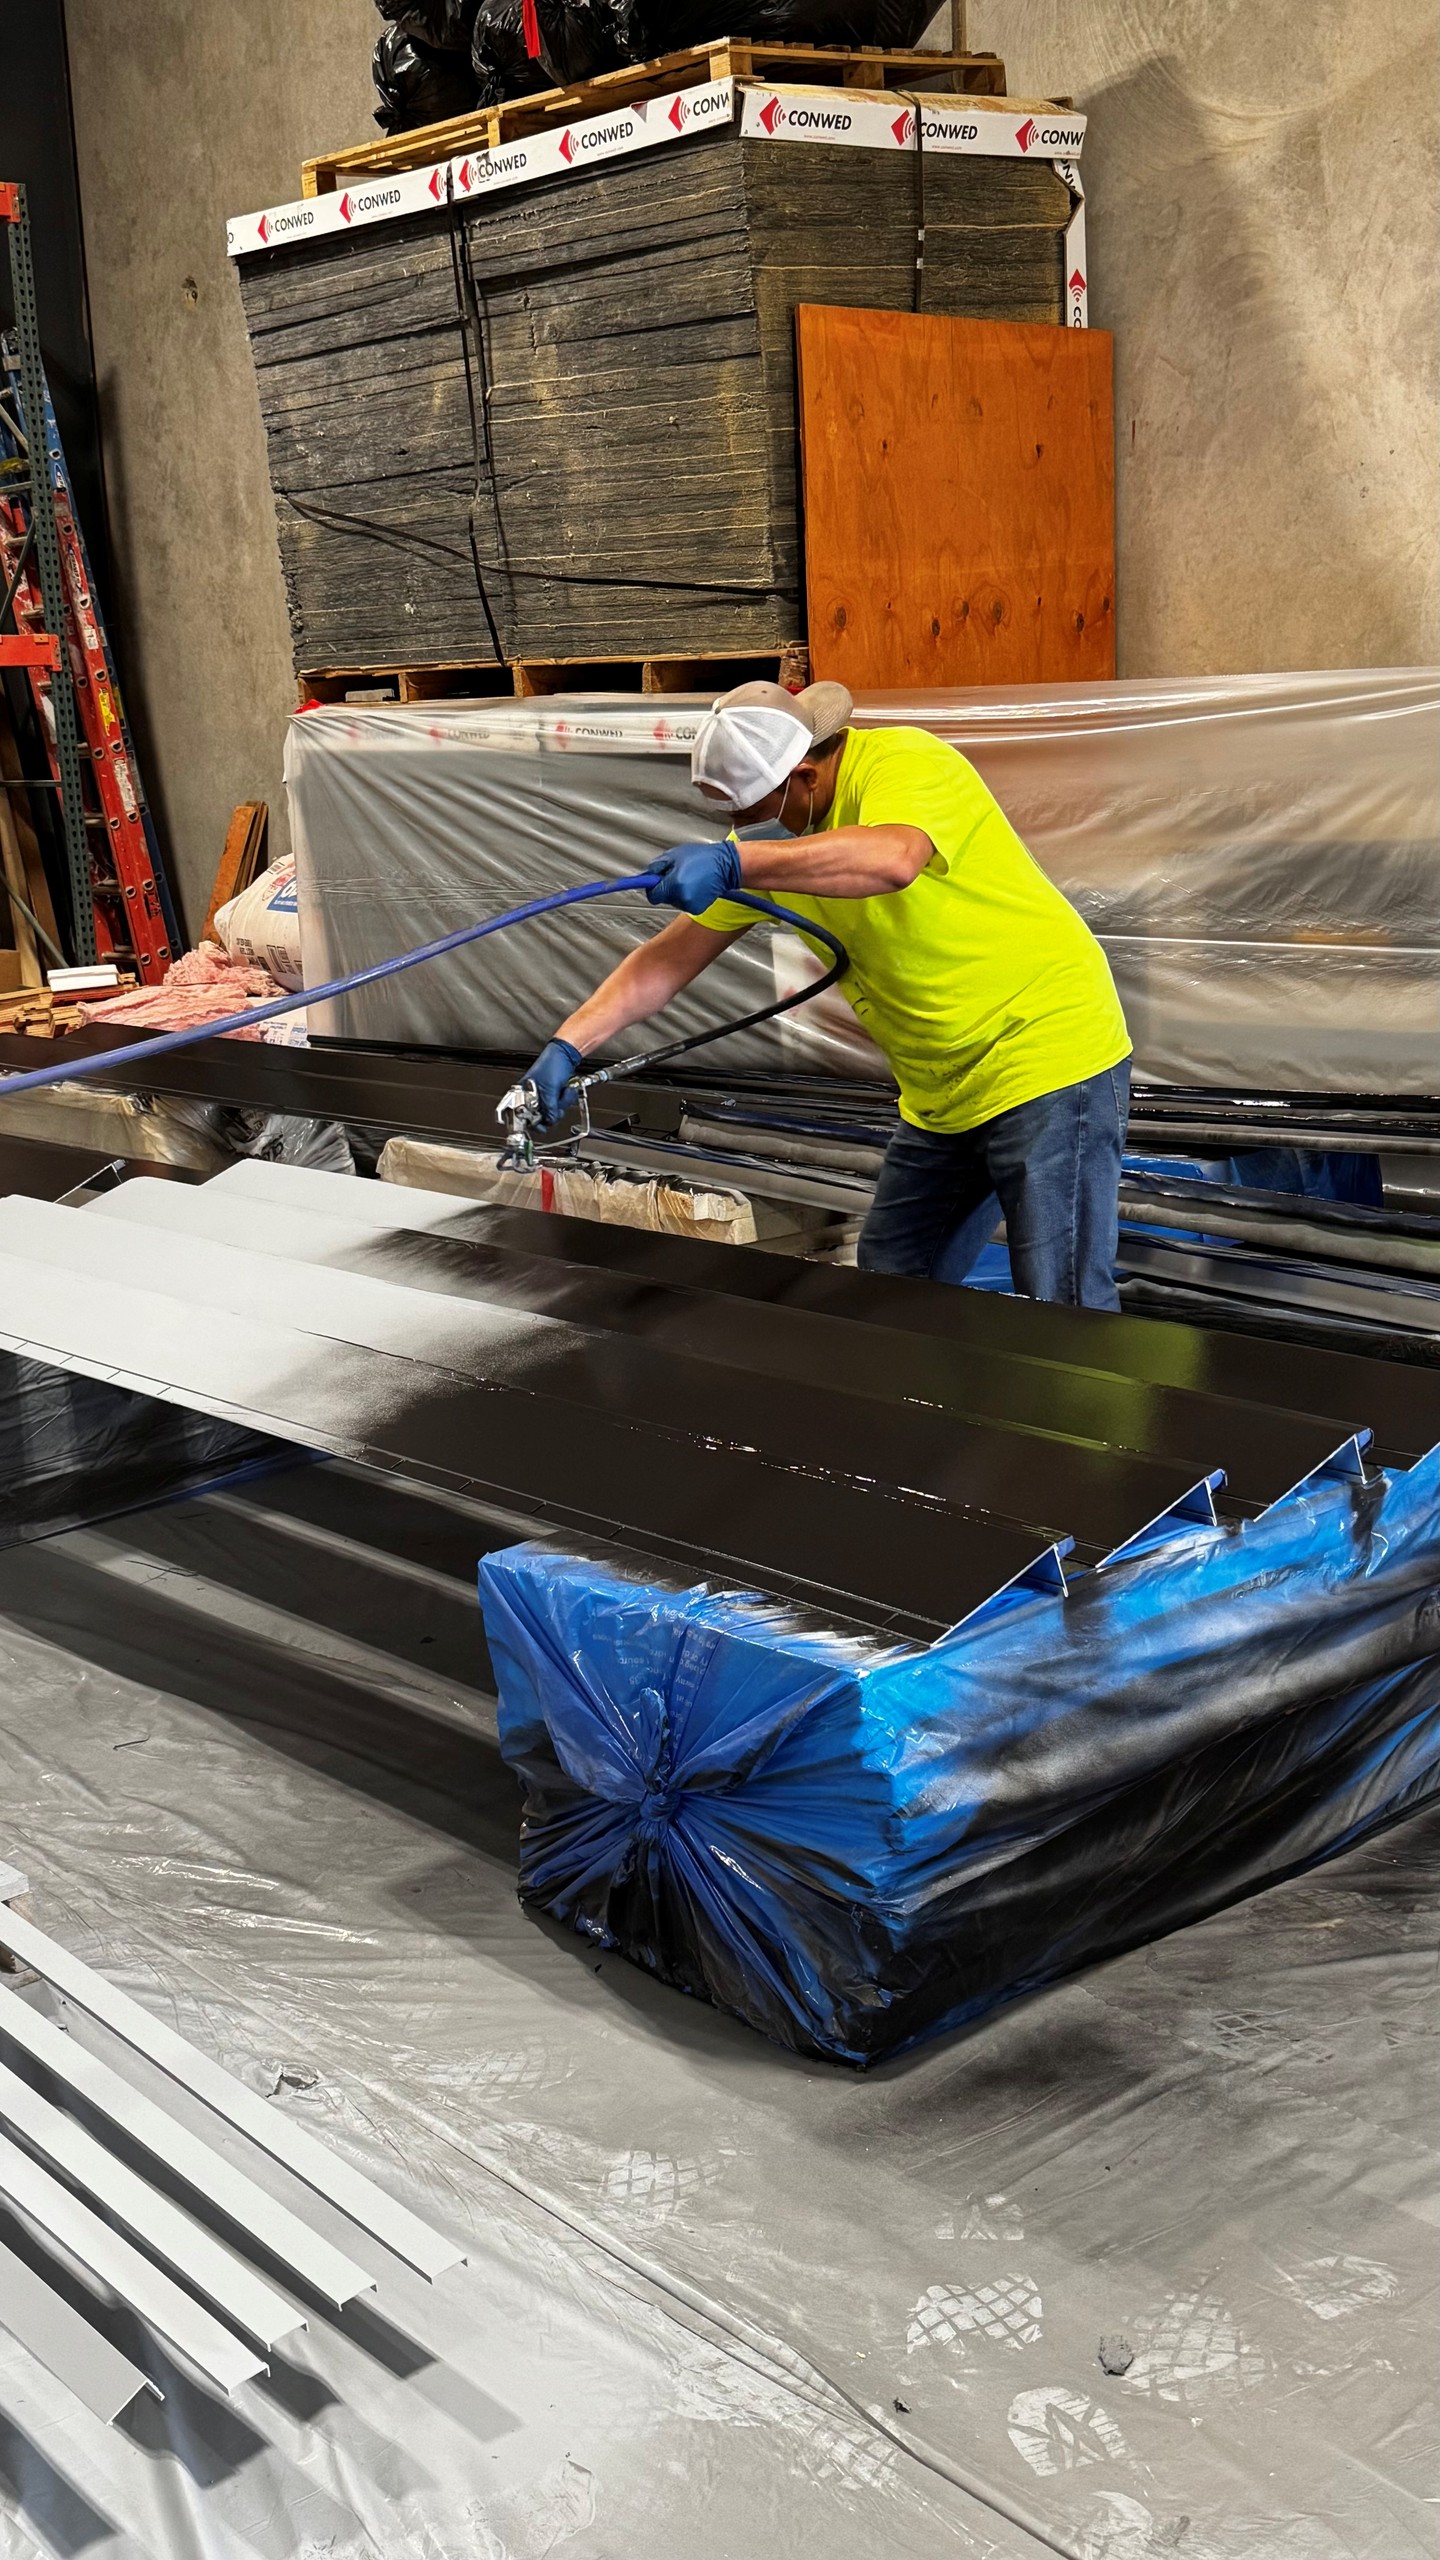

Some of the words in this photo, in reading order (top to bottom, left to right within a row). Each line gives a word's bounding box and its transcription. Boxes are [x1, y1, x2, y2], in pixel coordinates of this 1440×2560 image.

[788, 110, 852, 131] CONWED
[921, 122, 978, 140] CONWED
[581, 121, 634, 149] CONWED
[1041, 129, 1084, 146] CONW
[478, 153, 527, 178] CONWED
[358, 189, 401, 212] CONWED
[274, 211, 314, 233] CONWED
